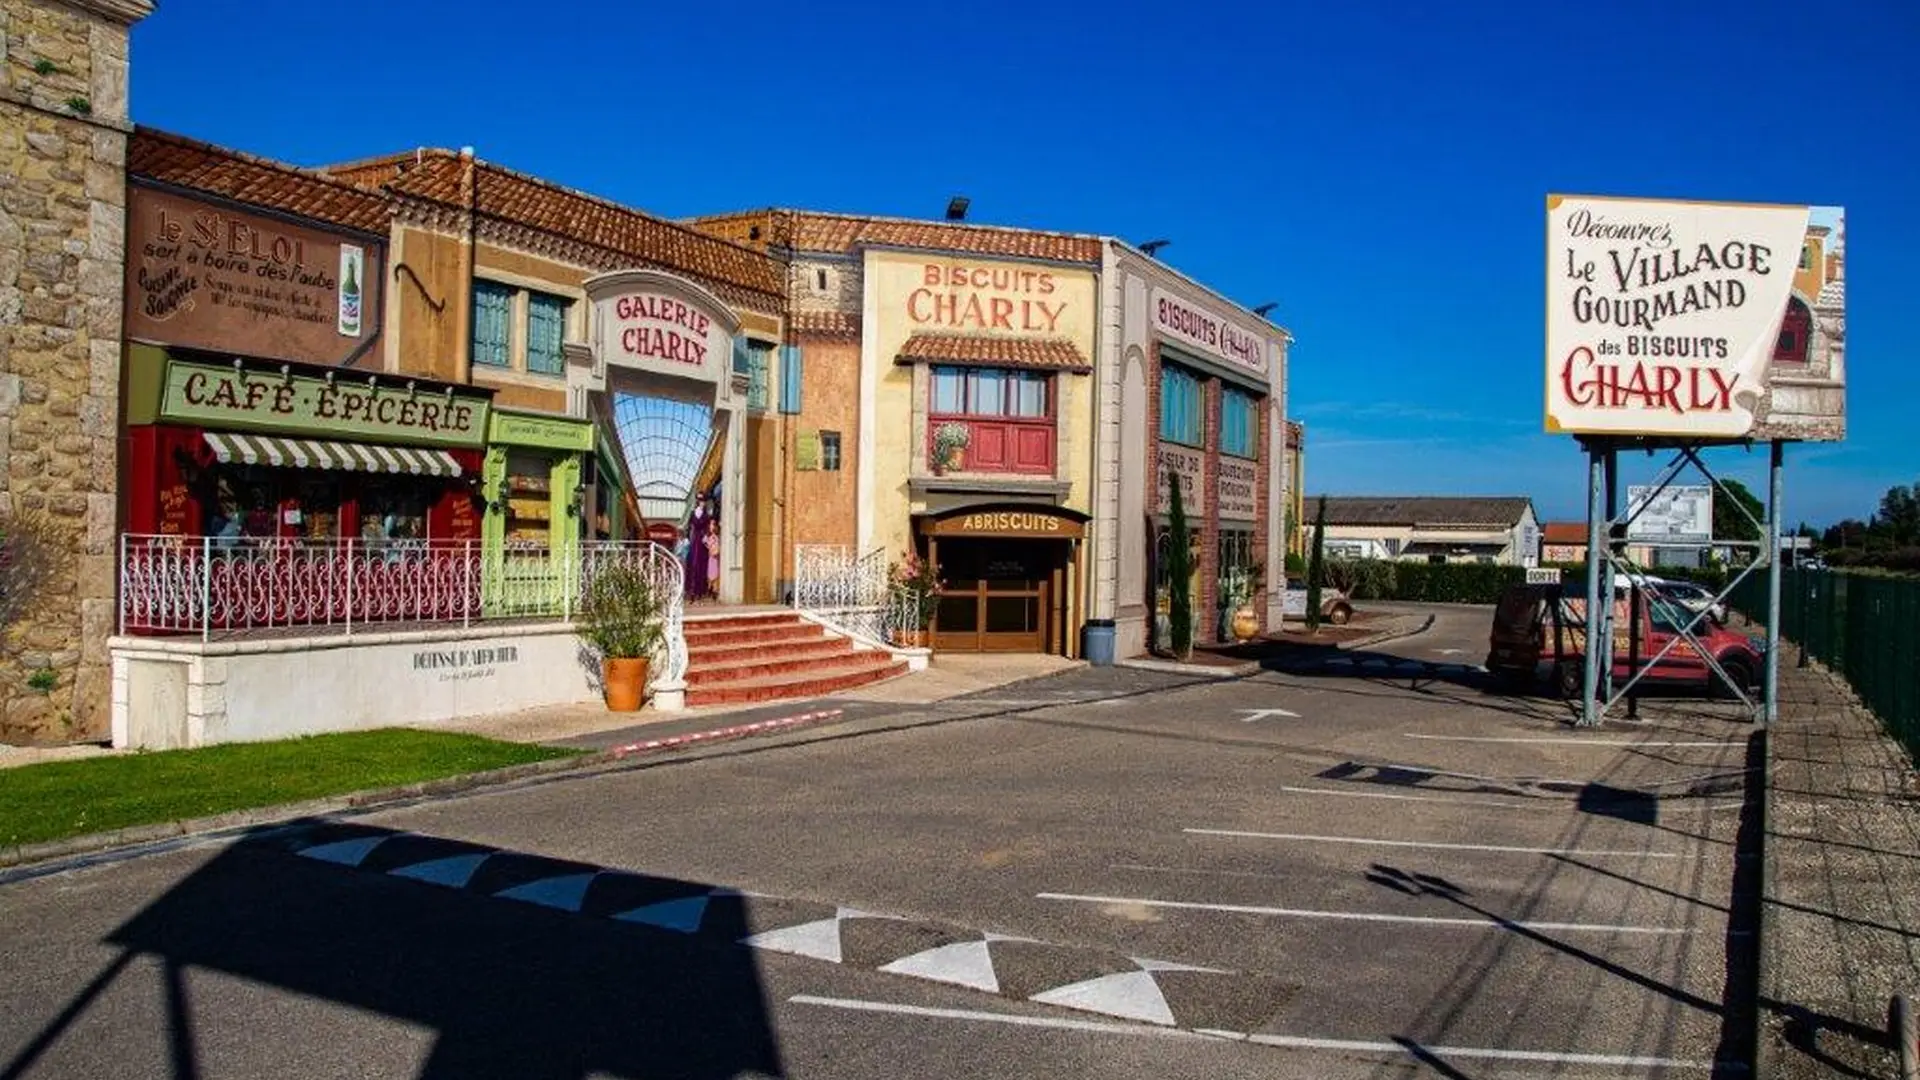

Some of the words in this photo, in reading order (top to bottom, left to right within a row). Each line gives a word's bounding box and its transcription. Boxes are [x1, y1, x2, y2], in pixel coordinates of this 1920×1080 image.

[157, 210, 183, 243] le
[203, 251, 248, 273] boire
[924, 264, 1055, 295] BISCUITS
[1566, 248, 1595, 282] Le
[1609, 241, 1772, 294] VILLAGE
[616, 295, 710, 339] GALERIE
[906, 287, 1067, 332] CHARLY
[1158, 297, 1216, 346] BISCUITS
[1572, 279, 1746, 331] GOURMAND
[621, 327, 708, 366] CHARLY
[1597, 338, 1622, 356] des
[1627, 335, 1729, 359] BISCUITS
[1561, 346, 1740, 413] CHARLY
[963, 514, 1060, 531] ABRISCUITS
